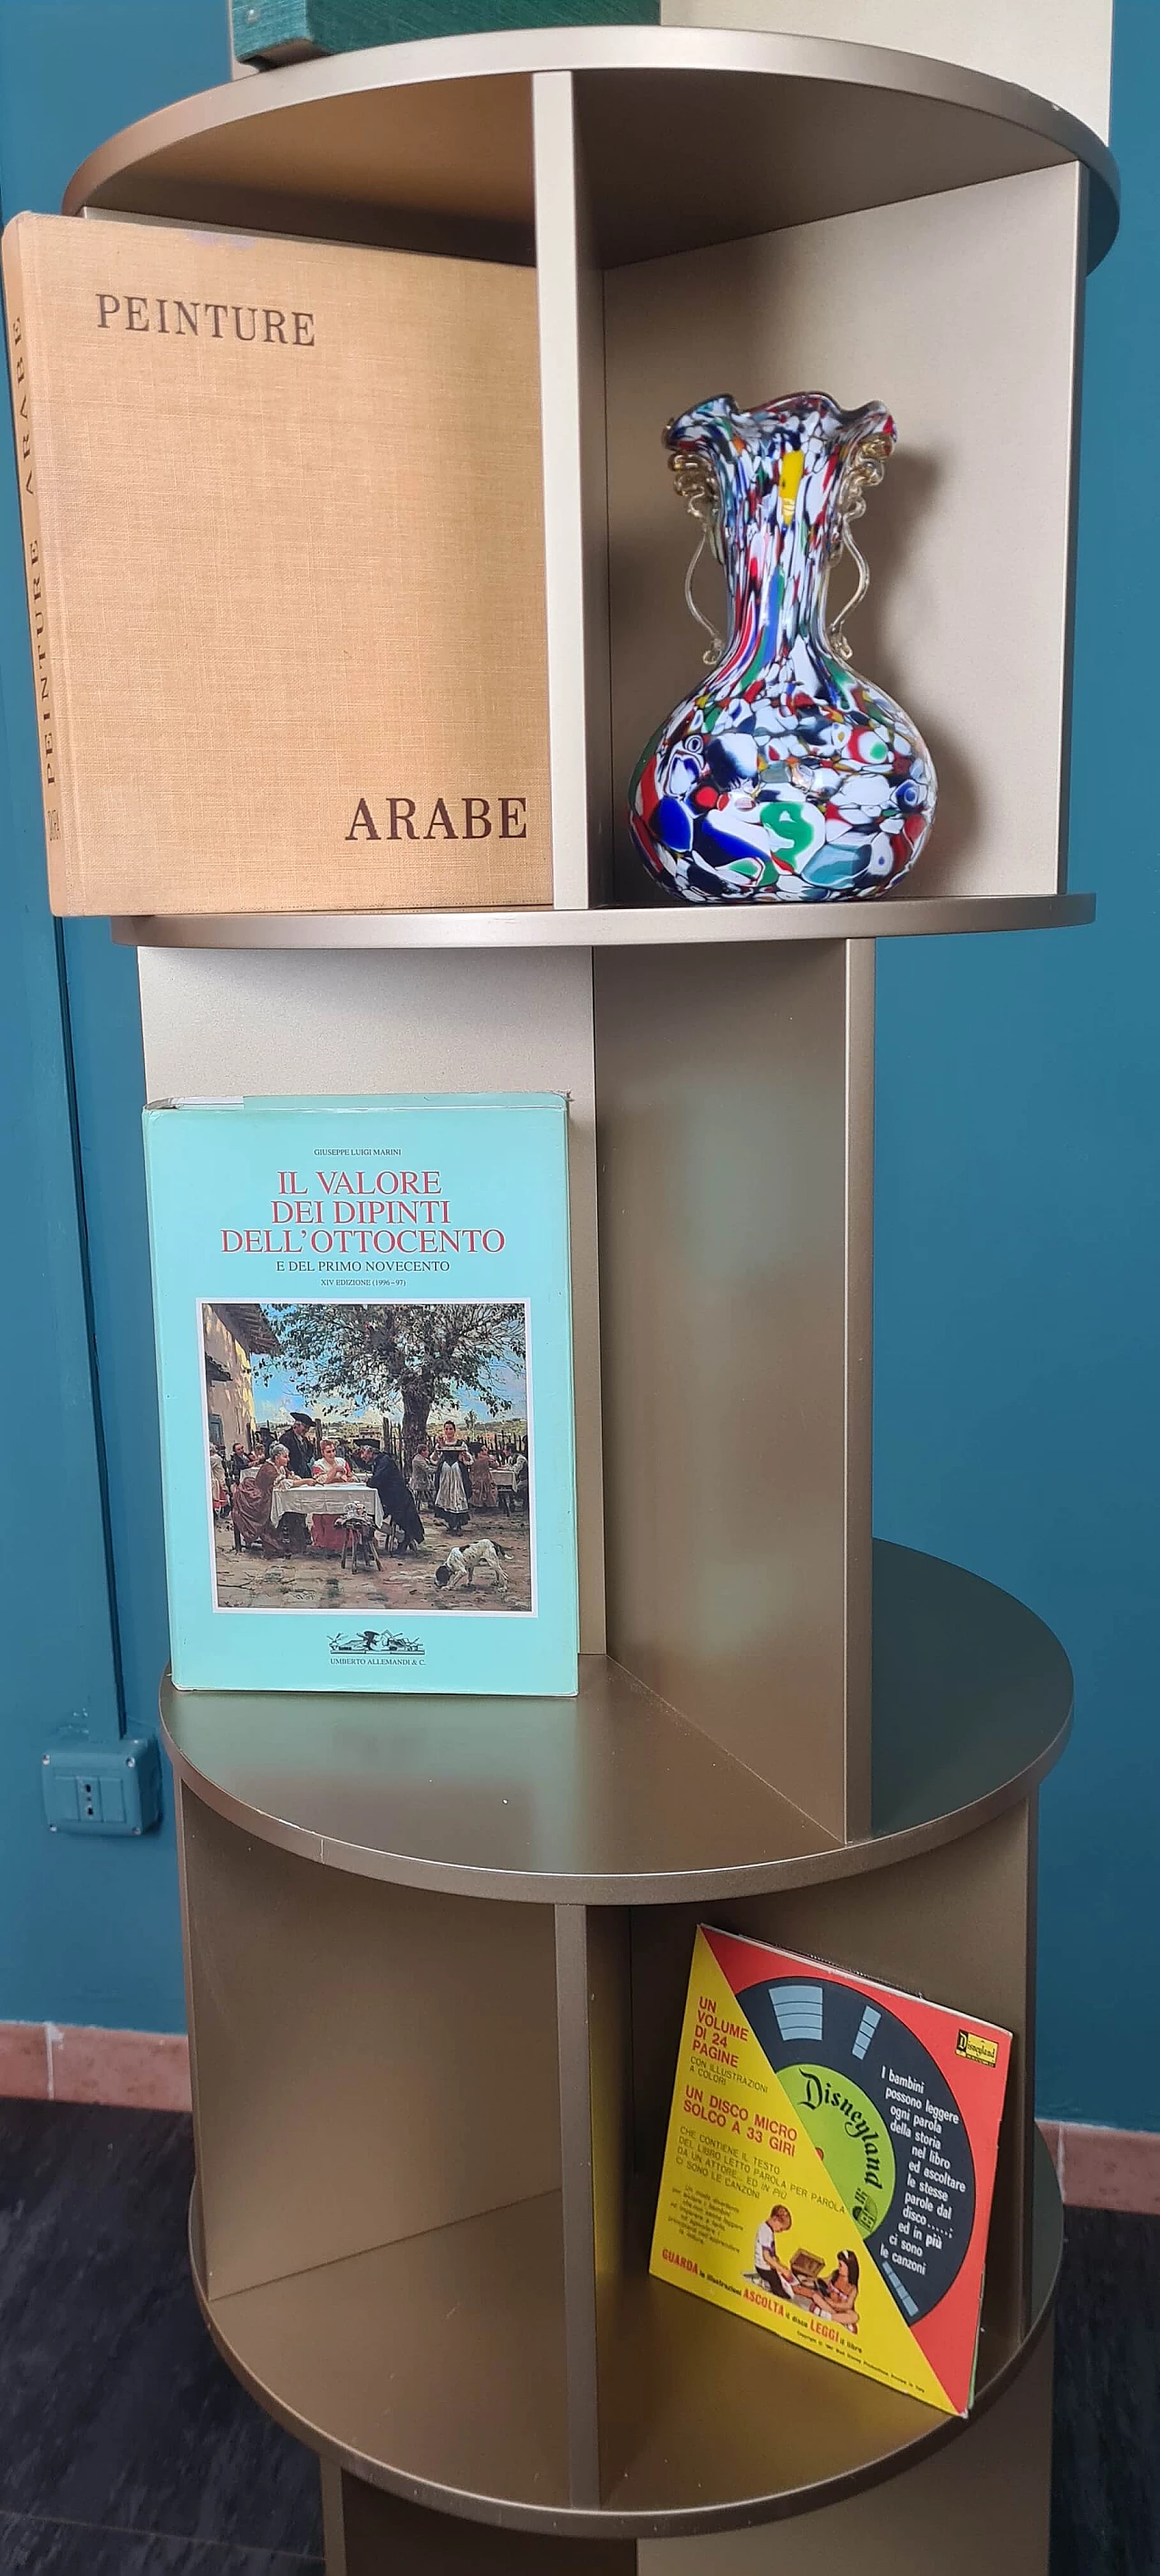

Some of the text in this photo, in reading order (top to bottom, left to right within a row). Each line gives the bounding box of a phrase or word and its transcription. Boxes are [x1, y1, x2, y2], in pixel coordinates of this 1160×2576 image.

[95, 293, 314, 346] PEINTURE
[13, 317, 34, 494] ARABE
[30, 540, 55, 784] PEINTURE
[344, 798, 527, 840] ARABE
[277, 1171, 442, 1195] IL VALORE
[271, 1200, 451, 1224] DEI DIPINTI
[220, 1229, 506, 1253] DELL'OTTOCENTO
[276, 1261, 450, 1272] E DEL PRIMO NOVECENTO
[700, 1996, 717, 2012] UN
[695, 2025, 727, 2048] DI 24
[698, 2010, 749, 2041] VOLUME
[692, 2039, 739, 2068] PAGINE
[691, 2056, 768, 2093] CON ILLUSTRAZIONI
[698, 2068, 726, 2085] COLORI
[881, 2066, 924, 2094] I bambini
[686, 2085, 798, 2141] UN DISCO MICRO
[885, 2087, 959, 2124] possono leggere
[890, 2106, 942, 2134] ogni parola
[683, 2100, 796, 2157] SOLCO A 33 GIRI
[798, 2068, 883, 2190] Disneyland
[890, 2119, 941, 2150] della storia
[681, 2126, 779, 2174] CHE CONTIENE IL TESTO
[912, 2145, 950, 2169] nel libro
[677, 2146, 688, 2156] DA
[691, 2152, 701, 2163] UN
[747, 2176, 758, 2187] ED
[761, 2183, 769, 2192] IN
[680, 2136, 845, 2213] DEL LIBRO LETTO PAROLA PER PAROLA
[687, 2161, 709, 2176] SONO
[711, 2172, 722, 2183] LE
[725, 2177, 759, 2199] CANZONI
[909, 2161, 966, 2193] ed ascoltare
[907, 2174, 948, 2202] le stesse
[904, 2193, 952, 2220] parole dal
[889, 2233, 923, 2257] ci sono
[898, 2222, 942, 2249] ed in più
[880, 2242, 926, 2275] le canzoni
[662, 2248, 698, 2275] GUARDA
[743, 2288, 785, 2316] ASCOLTA
[792, 2315, 808, 2328] disco
[809, 2319, 839, 2343] LEGGI
[846, 2339, 863, 2354] libro
